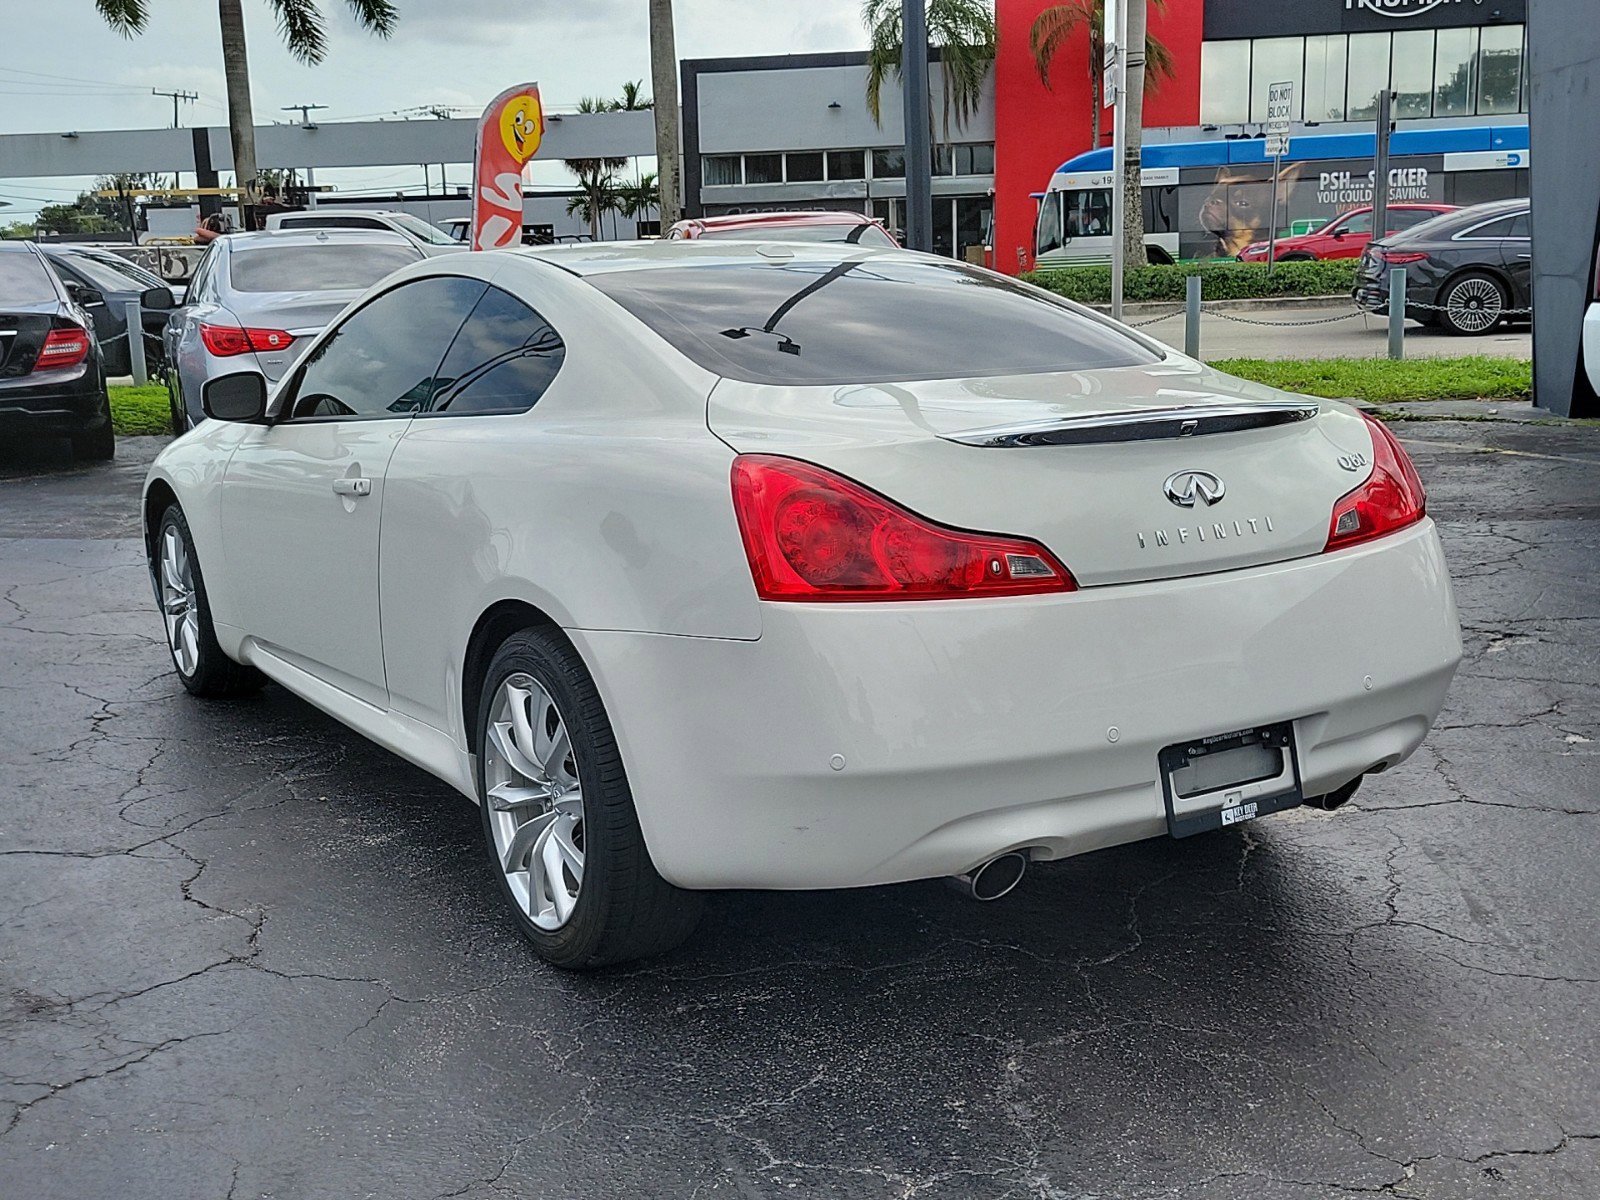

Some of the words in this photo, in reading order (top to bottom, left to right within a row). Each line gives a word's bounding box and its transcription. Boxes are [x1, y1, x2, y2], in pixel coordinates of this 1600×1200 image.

[1270, 91, 1278, 101] DO
[1280, 88, 1291, 100] NOT
[1269, 105, 1290, 118] BLOCK
[1102, 176, 1115, 185] 19
[1320, 171, 1364, 190] PSH...
[1368, 168, 1428, 189] SCKER
[1317, 191, 1337, 204] YOU
[1340, 189, 1372, 203] COULD
[1389, 187, 1430, 200] SAVING.
[1337, 452, 1367, 472] Q60
[1137, 516, 1274, 549] INFINITI
[1234, 805, 1244, 817] KEY
